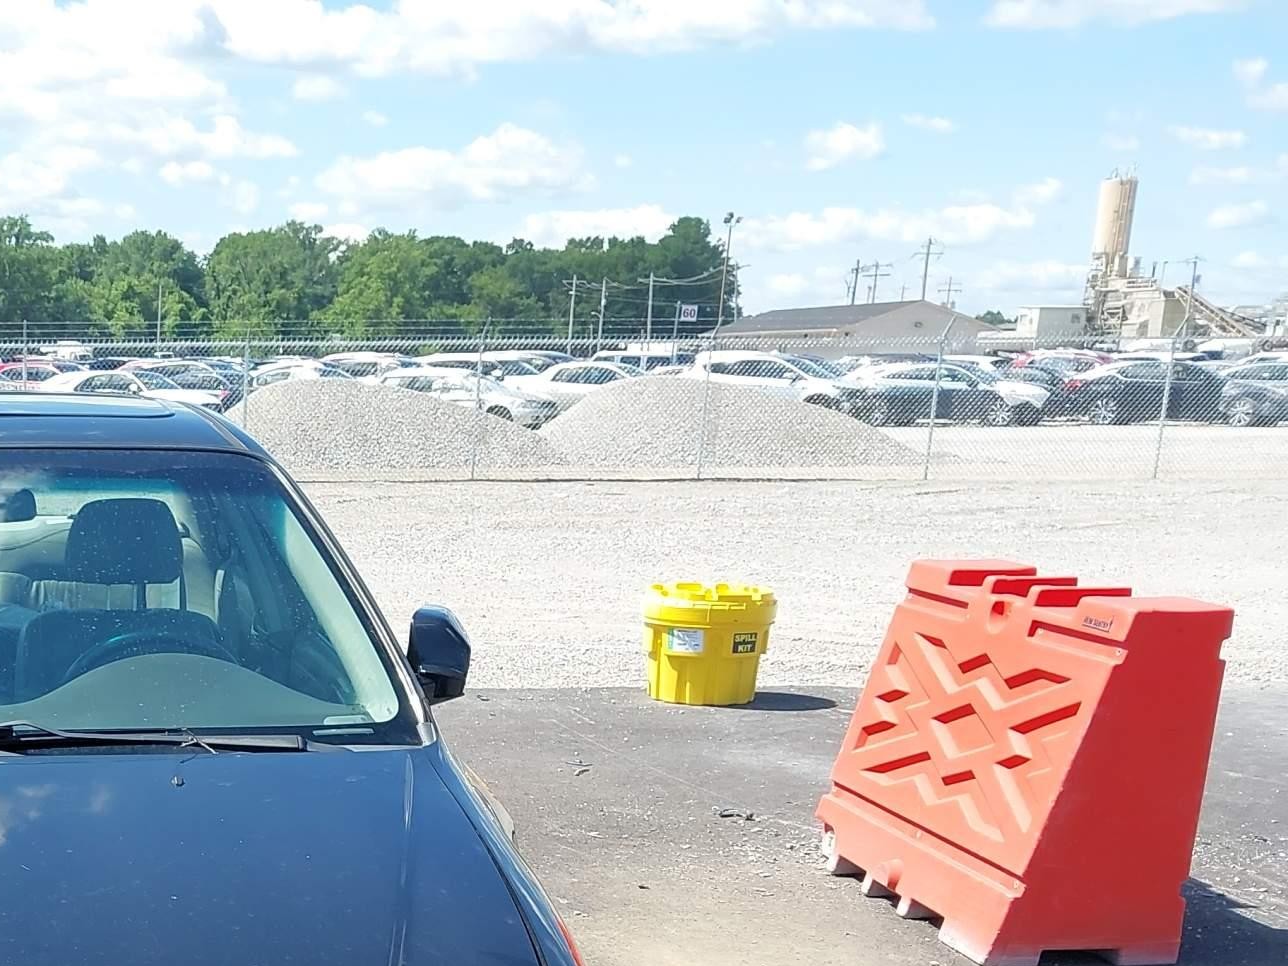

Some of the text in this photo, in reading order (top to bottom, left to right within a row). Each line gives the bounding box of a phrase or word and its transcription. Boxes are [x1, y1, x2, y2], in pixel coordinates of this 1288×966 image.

[683, 308, 696, 318] 60
[735, 633, 757, 642] SPILL
[737, 644, 752, 652] KIT
